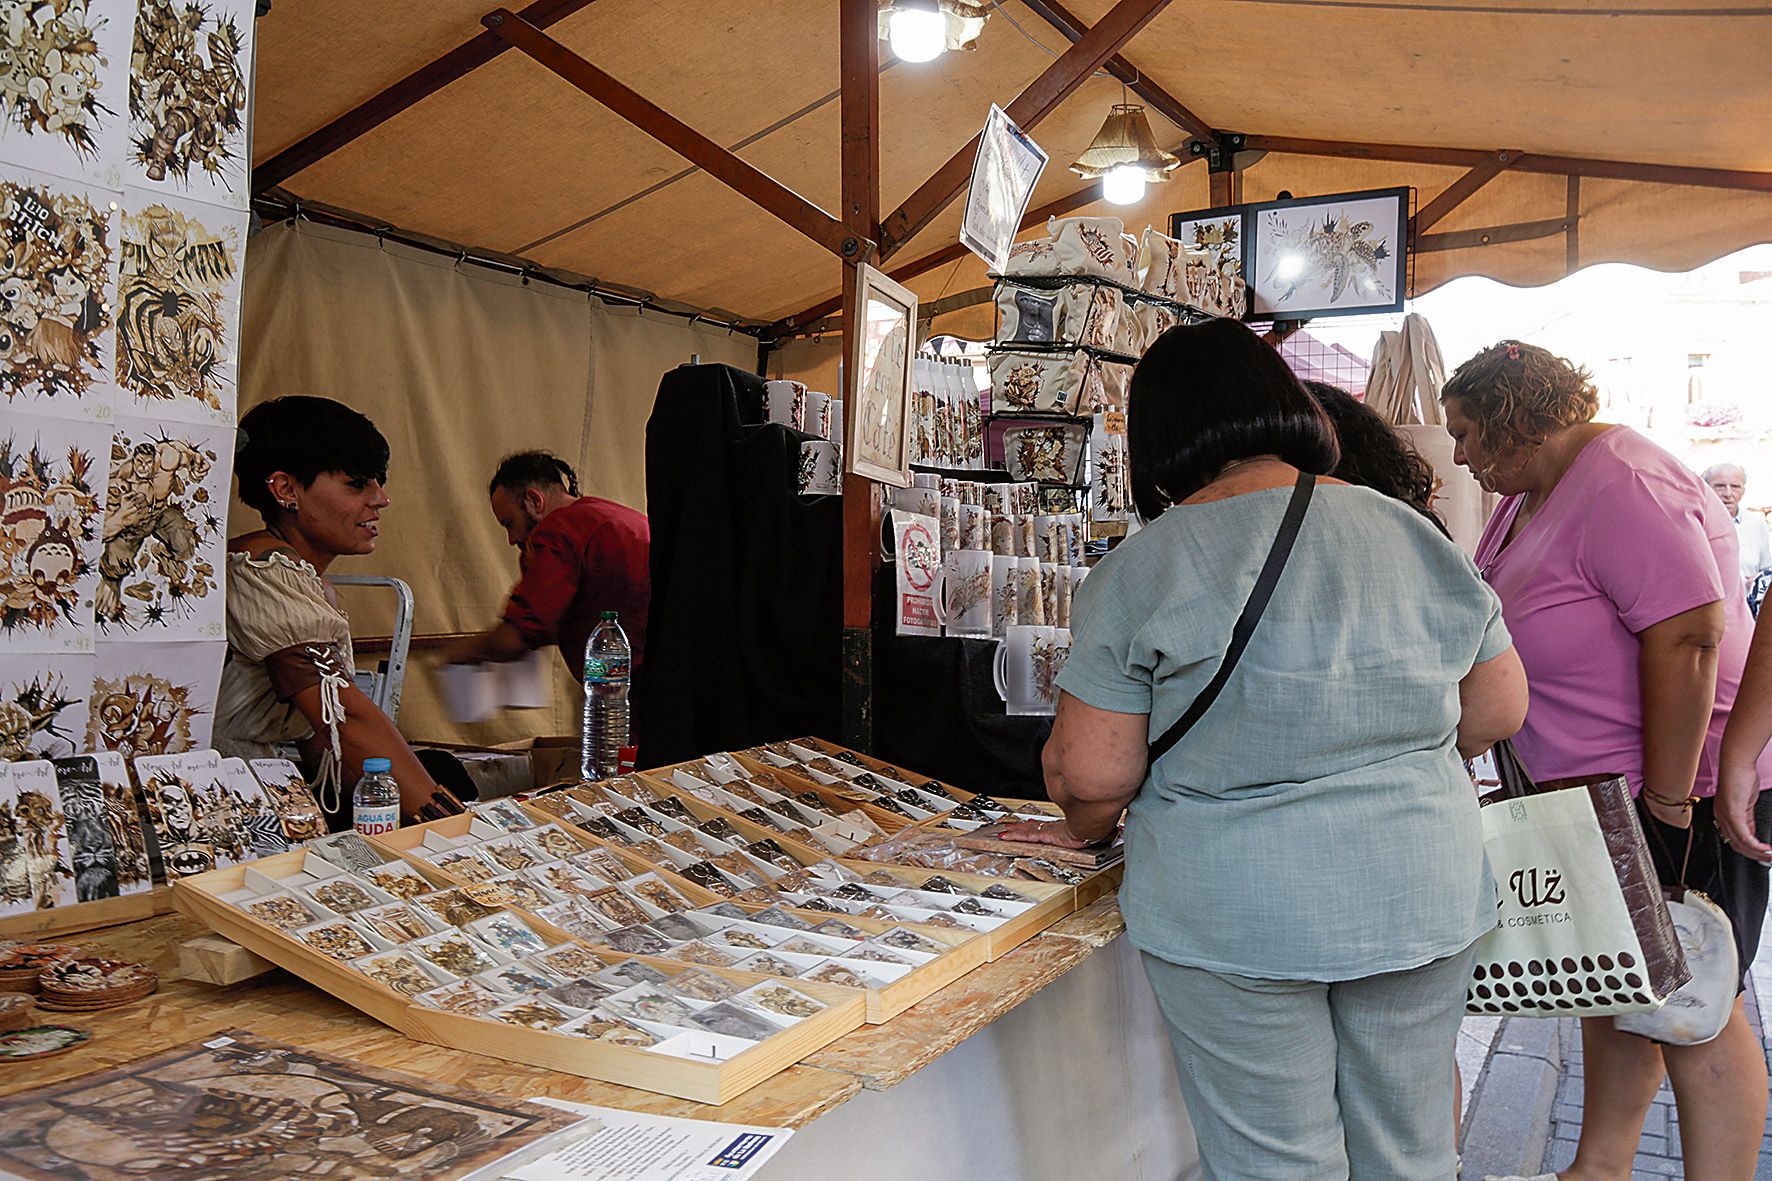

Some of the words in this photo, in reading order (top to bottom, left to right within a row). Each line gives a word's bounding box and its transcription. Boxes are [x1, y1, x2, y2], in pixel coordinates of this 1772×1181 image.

[95, 404, 111, 419] 20
[357, 814, 383, 822] AGUA
[385, 812, 395, 821] DE
[353, 822, 394, 836] EUDA
[1507, 911, 1572, 928] COSMÉTICA
